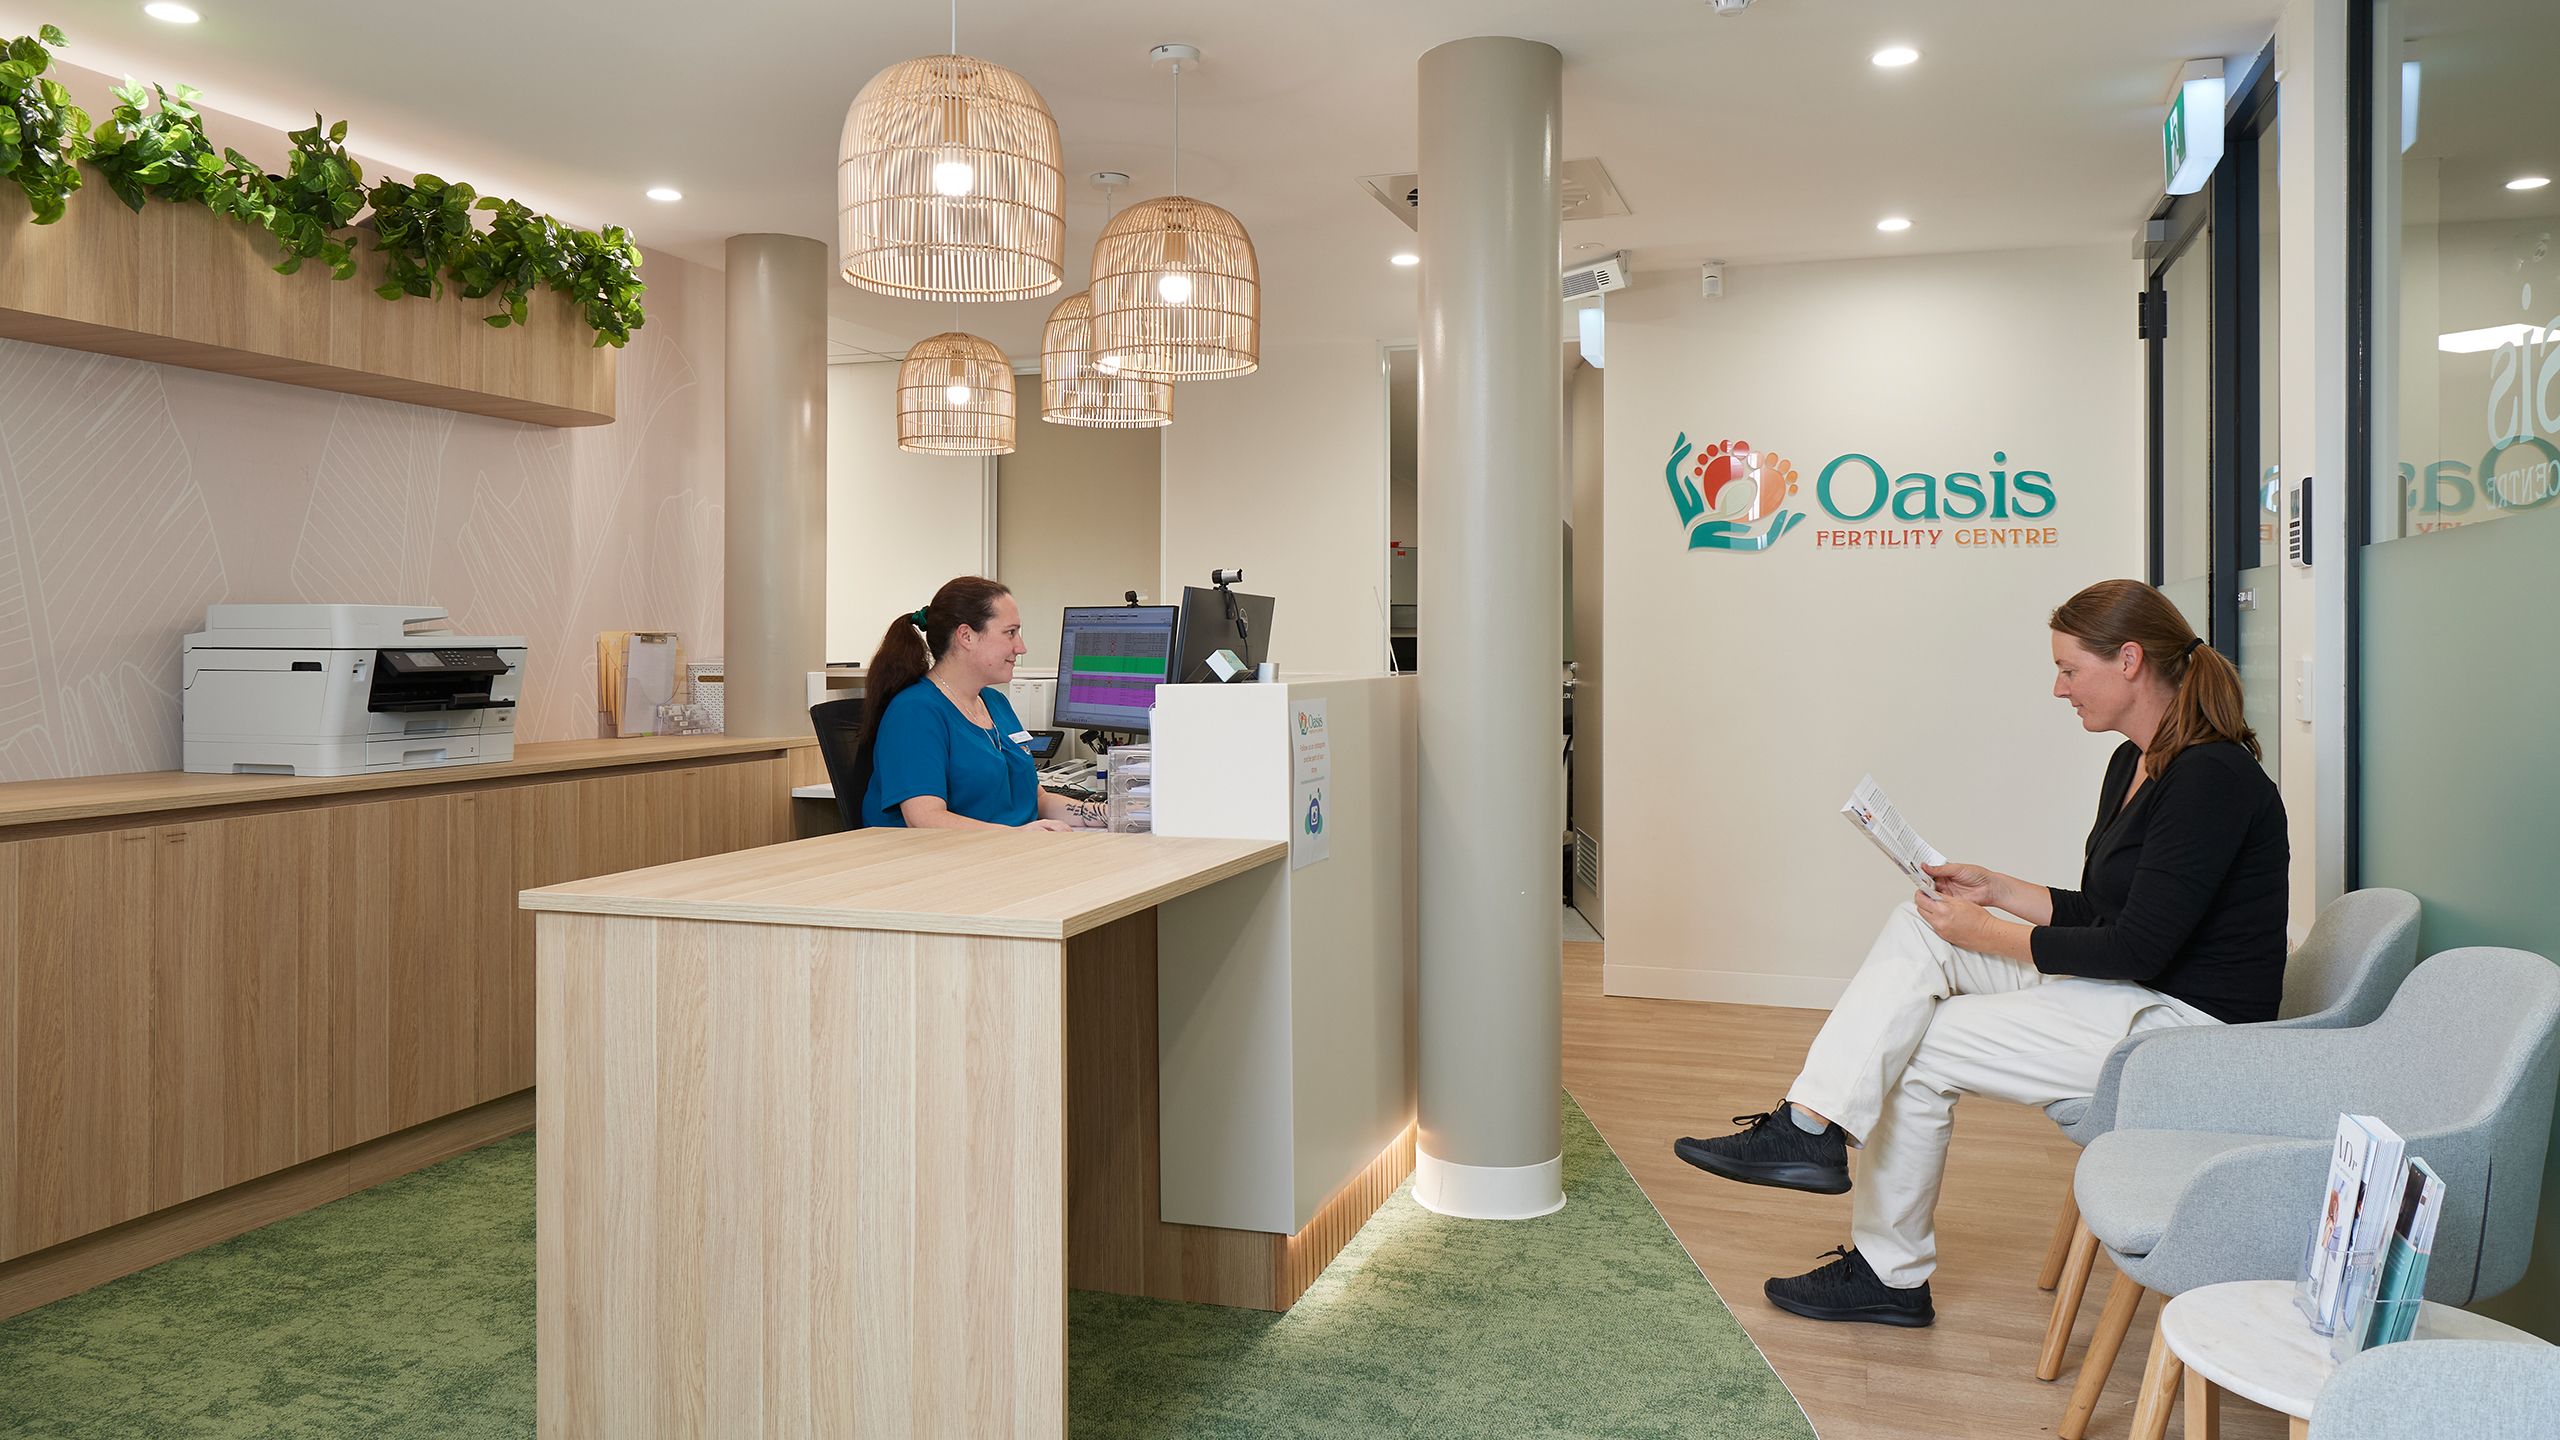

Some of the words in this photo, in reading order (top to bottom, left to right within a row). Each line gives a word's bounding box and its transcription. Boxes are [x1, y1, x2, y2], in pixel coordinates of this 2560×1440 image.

[1816, 450, 2057, 522] Oasis
[1816, 529, 1943, 548] FERTILITY
[1954, 527, 2058, 546] CENTRE
[1308, 713, 1323, 728] Oasis
